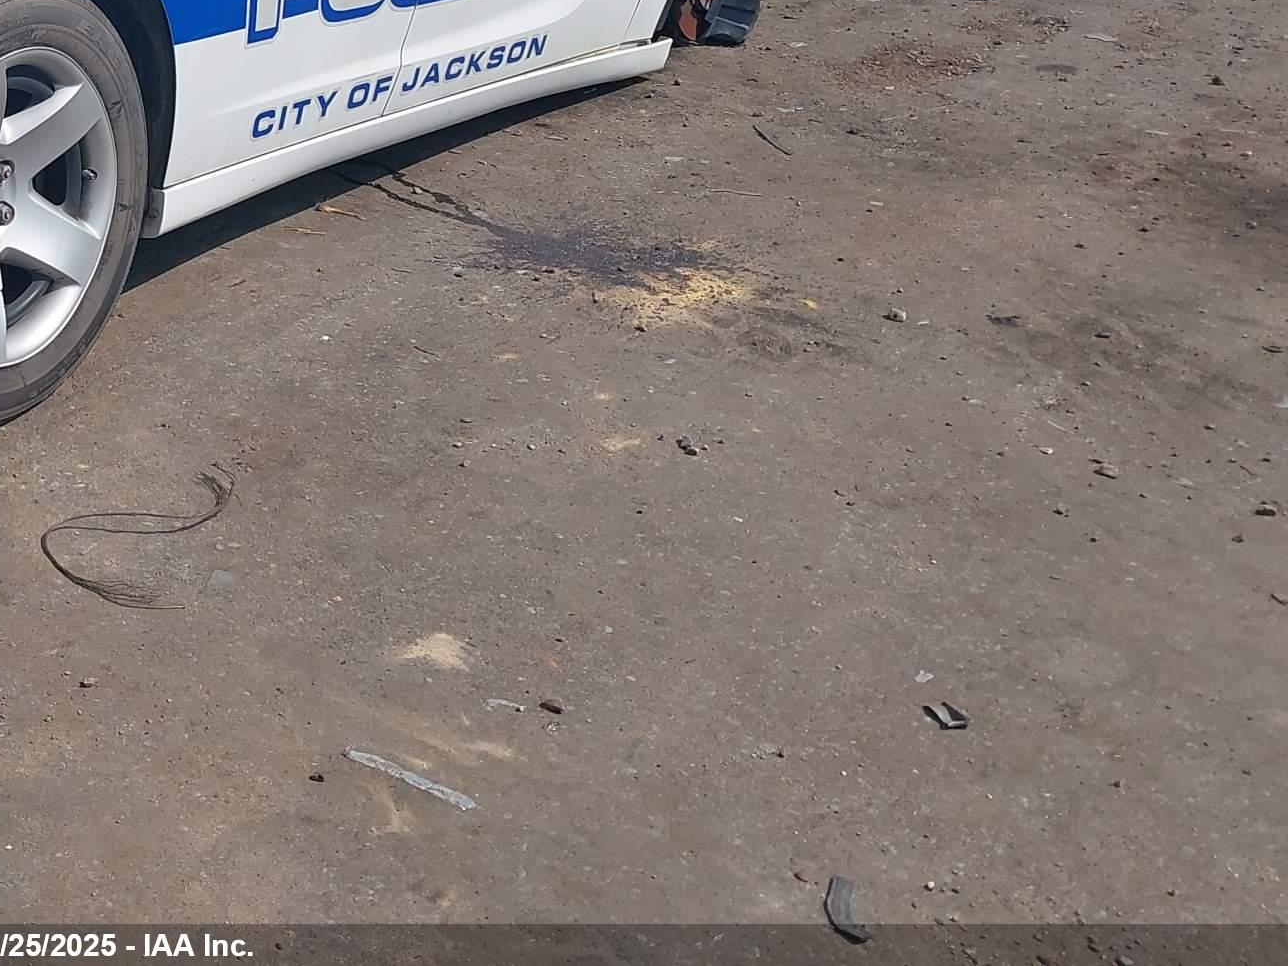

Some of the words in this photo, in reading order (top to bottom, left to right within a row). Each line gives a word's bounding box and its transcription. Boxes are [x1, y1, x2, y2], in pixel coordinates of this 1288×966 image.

[251, 90, 338, 140] CITY
[346, 75, 395, 109] OF
[401, 34, 548, 92] JACKSON
